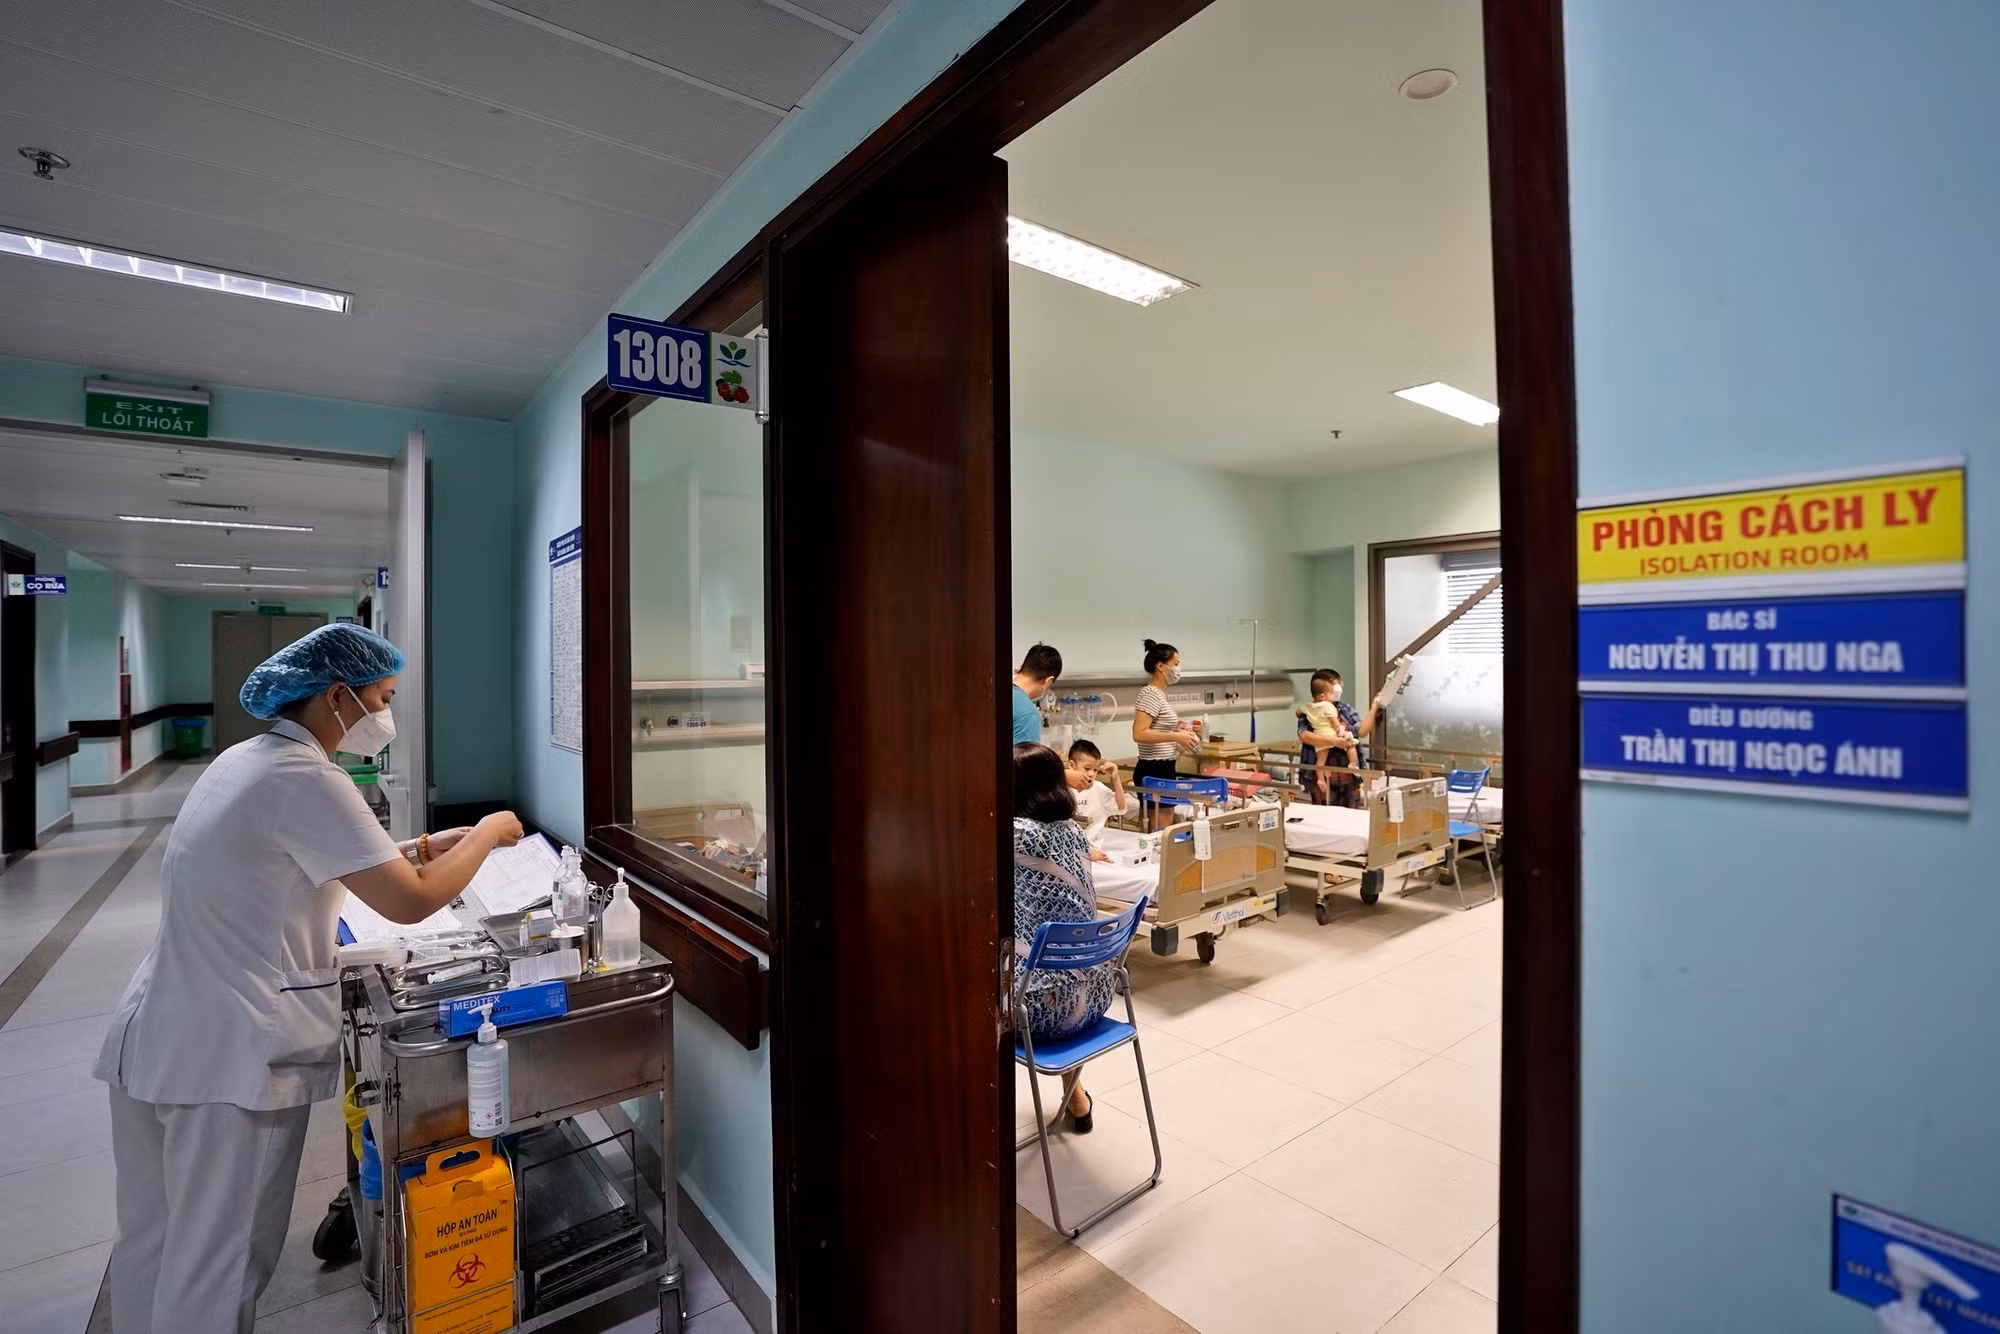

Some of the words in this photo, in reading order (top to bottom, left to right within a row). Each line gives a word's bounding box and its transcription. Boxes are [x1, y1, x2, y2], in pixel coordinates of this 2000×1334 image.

[613, 328, 702, 389] 1308
[115, 401, 183, 414] EXIT
[135, 415, 195, 432] THOÁT
[1594, 508, 1723, 552] PHÒNG
[1739, 495, 1864, 540] CÁCH
[1883, 487, 1937, 527] LY
[1640, 549, 1771, 576] ISOLATION
[1780, 542, 1869, 566] ROOM
[1706, 610, 1749, 631] BÁC
[1608, 635, 1705, 670] NGUYỄN
[1711, 643, 1759, 676] THỊ
[1766, 641, 1828, 672] THU
[1835, 641, 1904, 672] NGA
[1620, 727, 1686, 764] TRẦN
[1691, 738, 1737, 772] THỊ
[1744, 741, 1827, 777] NGỌC
[1834, 740, 1904, 779] ÁNH
[453, 994, 501, 1012] MEDITEX
[436, 1222, 457, 1239] HỘP
[458, 1217, 472, 1231] AN
[473, 1208, 498, 1225] TOÀN
[448, 1242, 460, 1252] KIM
